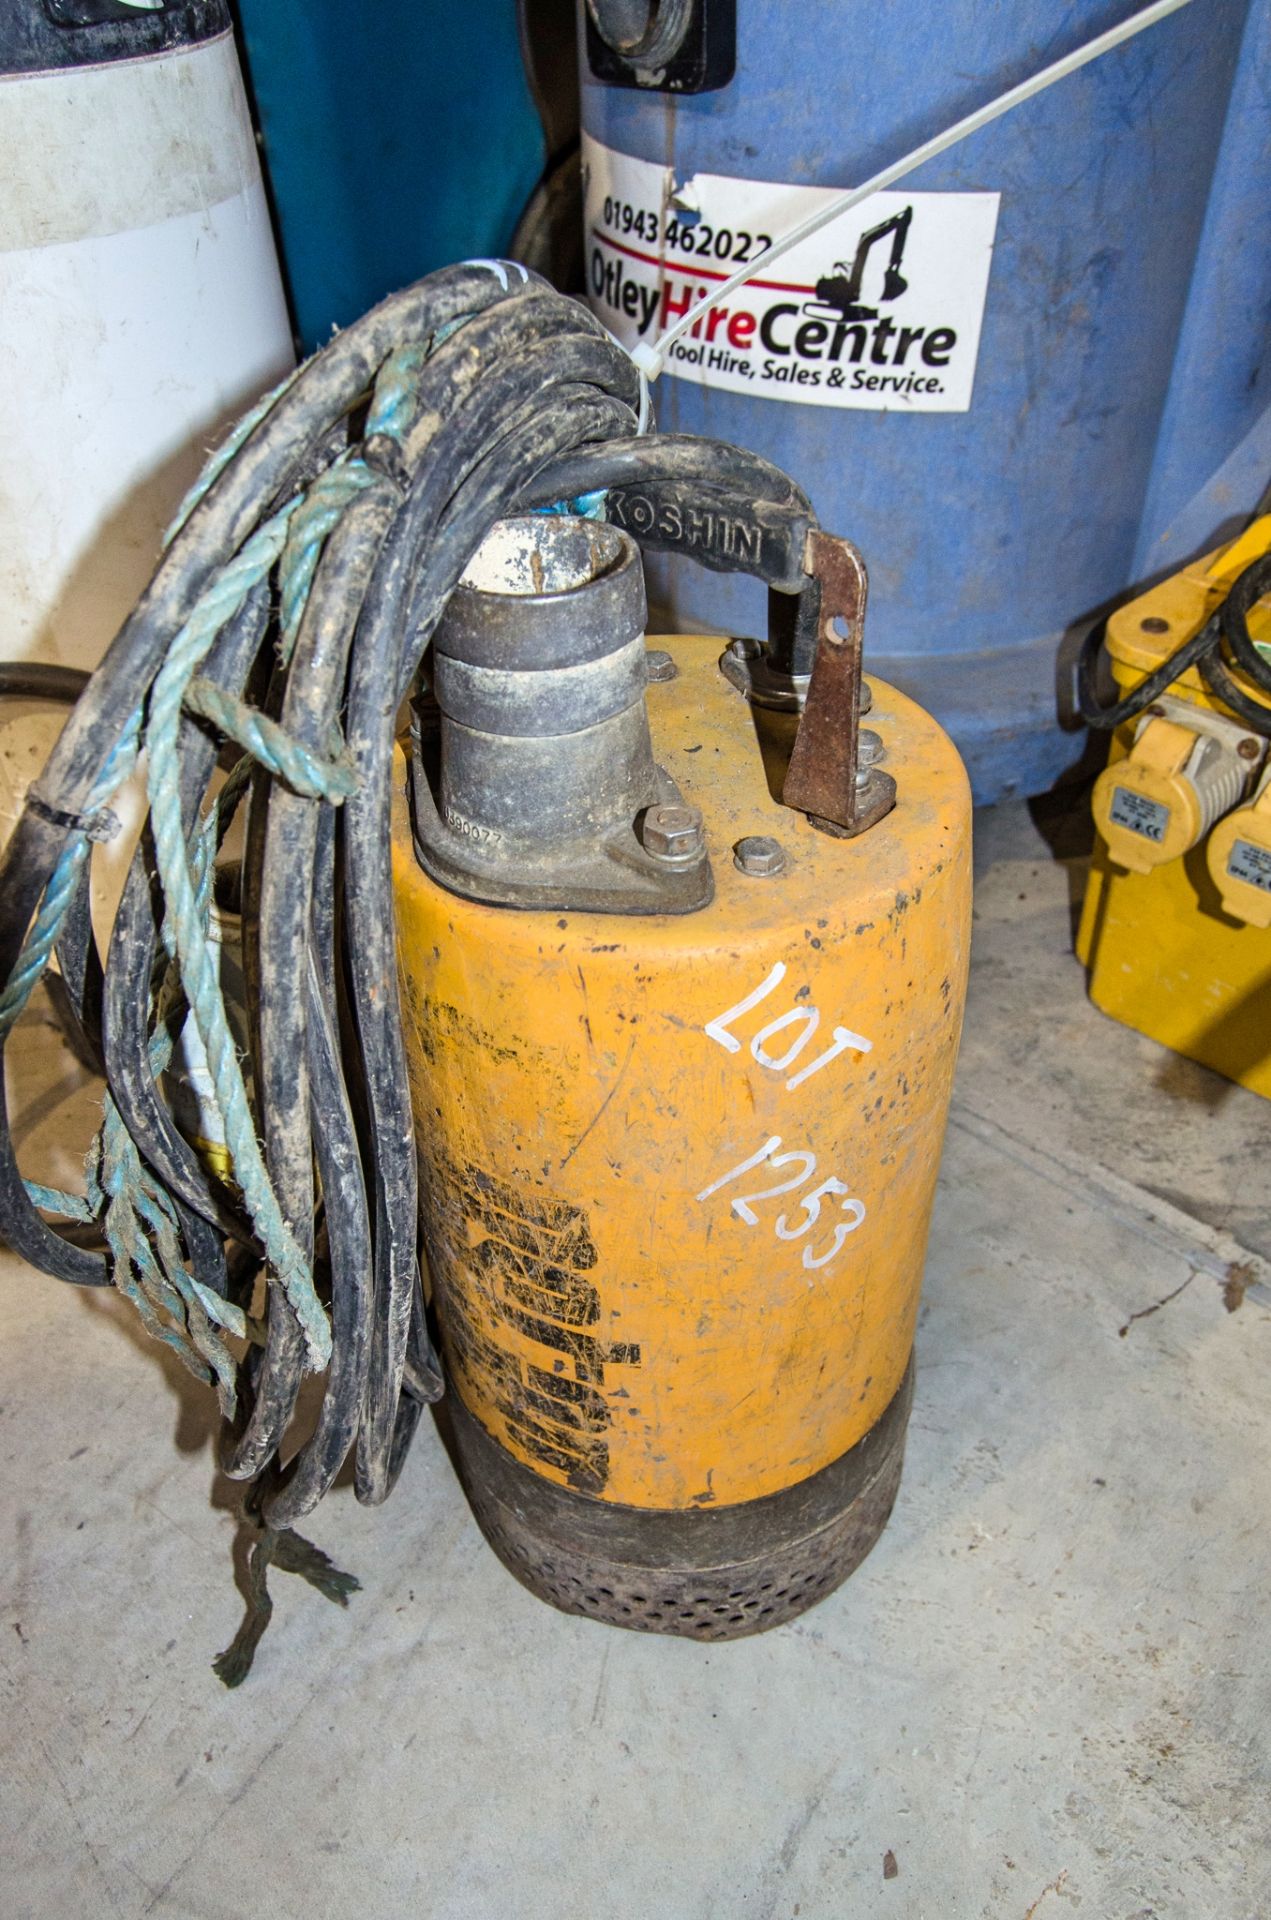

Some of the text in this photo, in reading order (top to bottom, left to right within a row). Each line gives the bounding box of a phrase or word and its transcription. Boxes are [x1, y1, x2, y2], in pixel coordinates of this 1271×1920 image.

[604, 196, 658, 243] 01943
[706, 348, 756, 380] Hire,
[761, 359, 822, 387] Sales
[826, 367, 845, 389] &
[850, 369, 945, 394] Service.
[606, 490, 763, 565] KOSHIN
[705, 961, 873, 1090] LOT
[695, 1135, 866, 1268] 1253
